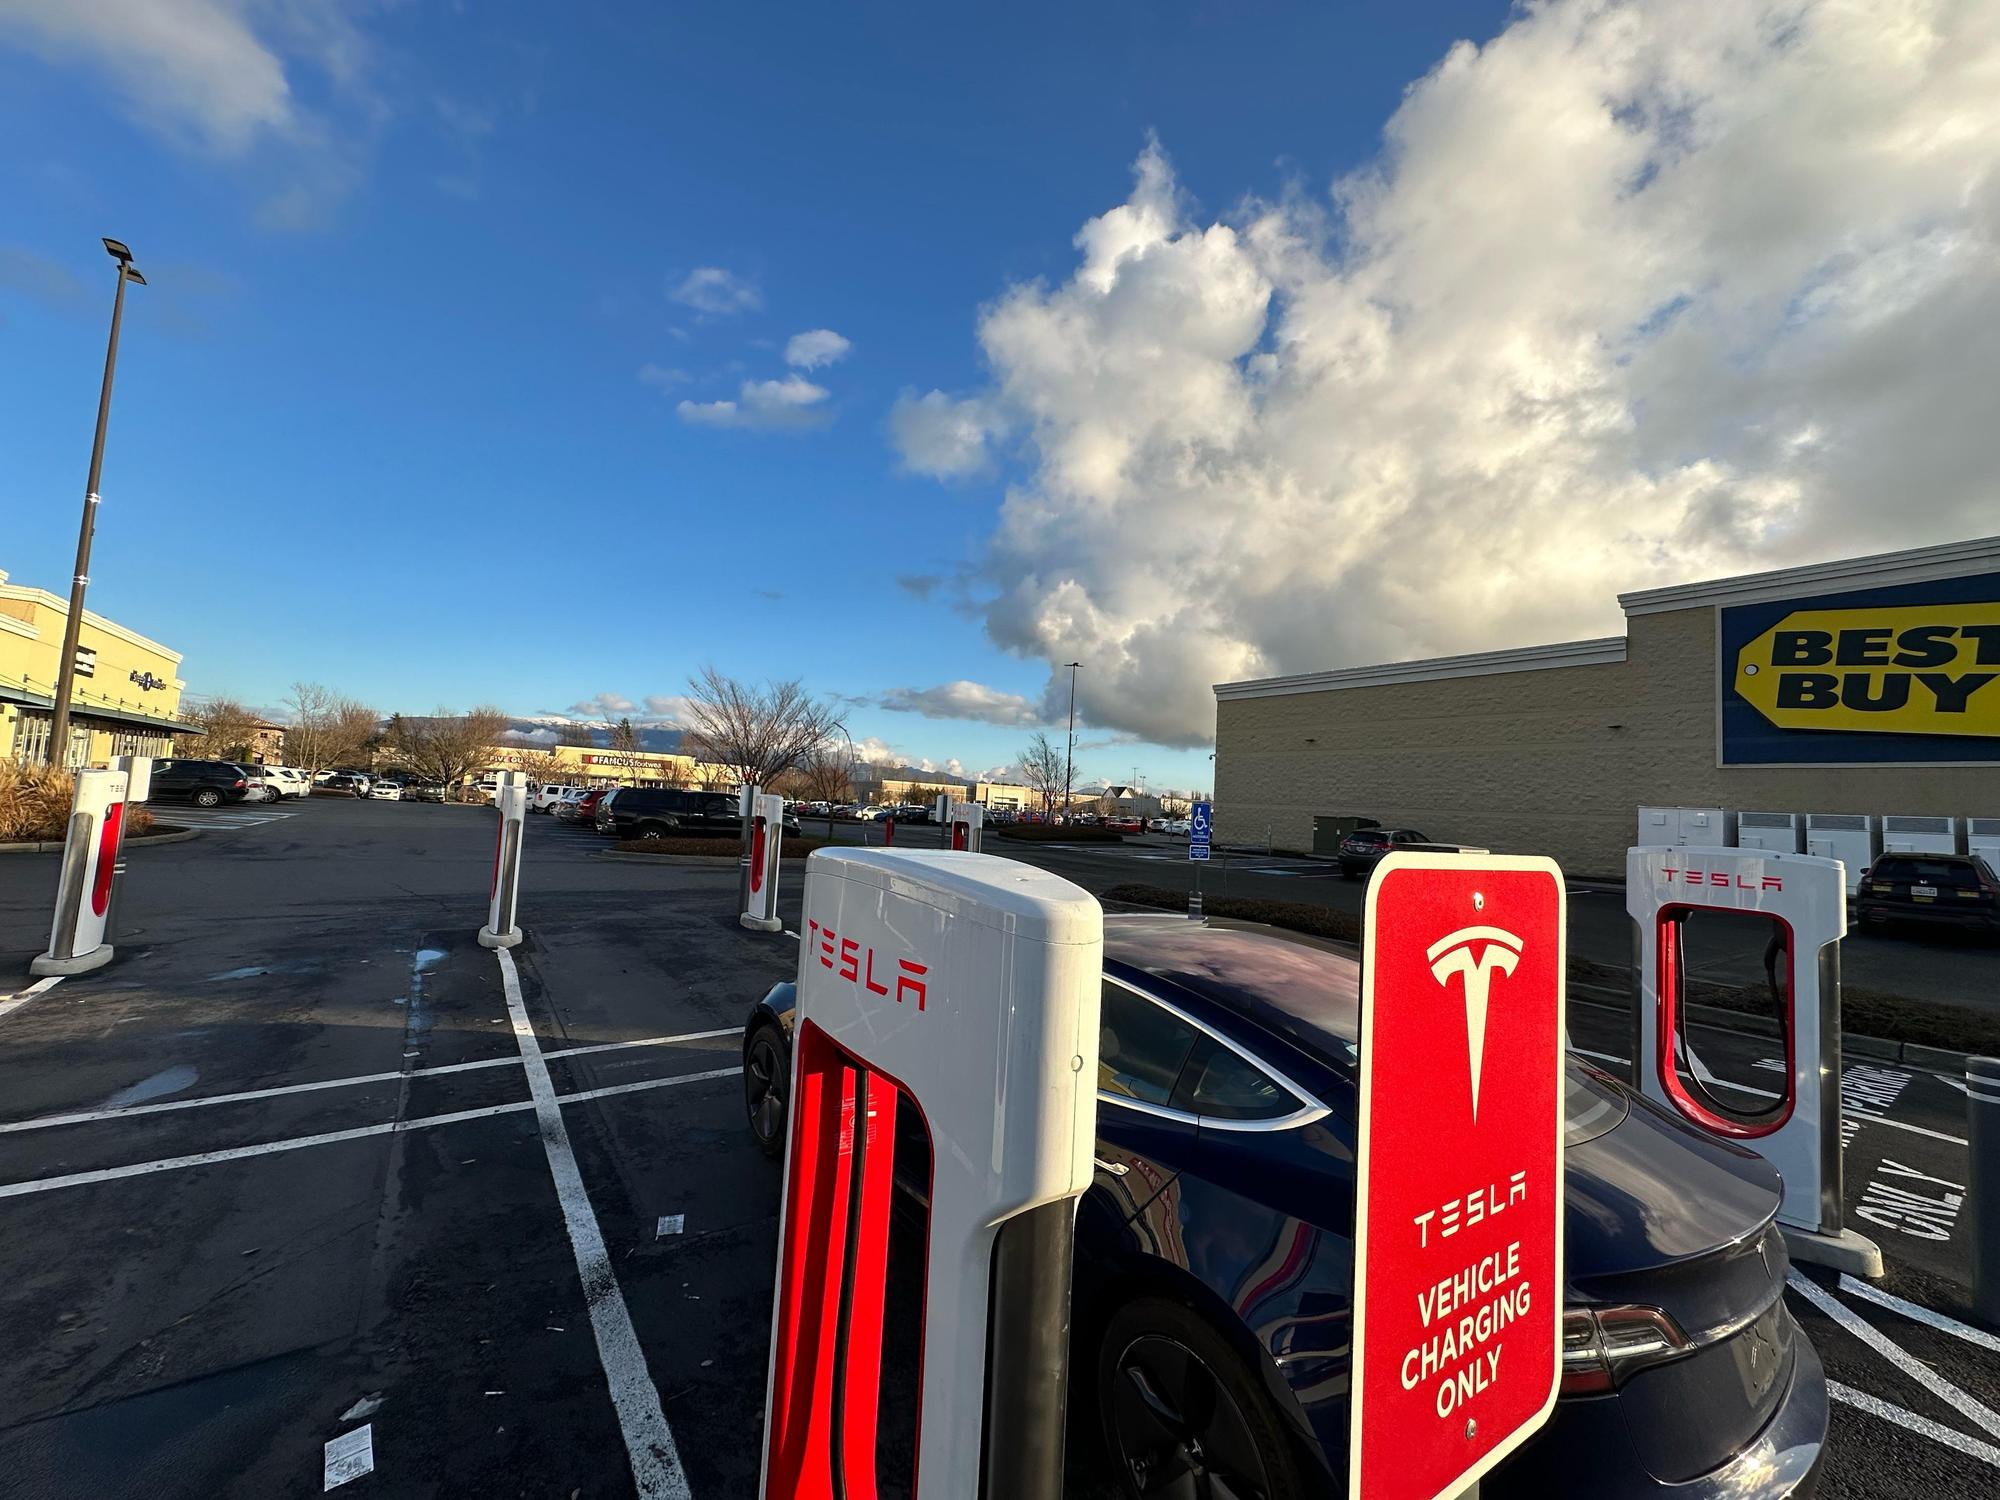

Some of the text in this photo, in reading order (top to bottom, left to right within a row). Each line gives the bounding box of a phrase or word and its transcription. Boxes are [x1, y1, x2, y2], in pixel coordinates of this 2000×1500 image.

[1771, 625, 2000, 668] BEST
[1776, 673, 2000, 713] BUY
[598, 756, 634, 767] FAMOUS
[1661, 868, 1782, 892] TESLA
[808, 918, 928, 1012] TESLA
[1413, 1170, 1526, 1248] TESLA
[1855, 1158, 1966, 1241] ONLY
[1417, 1240, 1520, 1328] VEHICLE
[1401, 1281, 1531, 1391] CHARGING
[1436, 1343, 1502, 1418] ONLY
